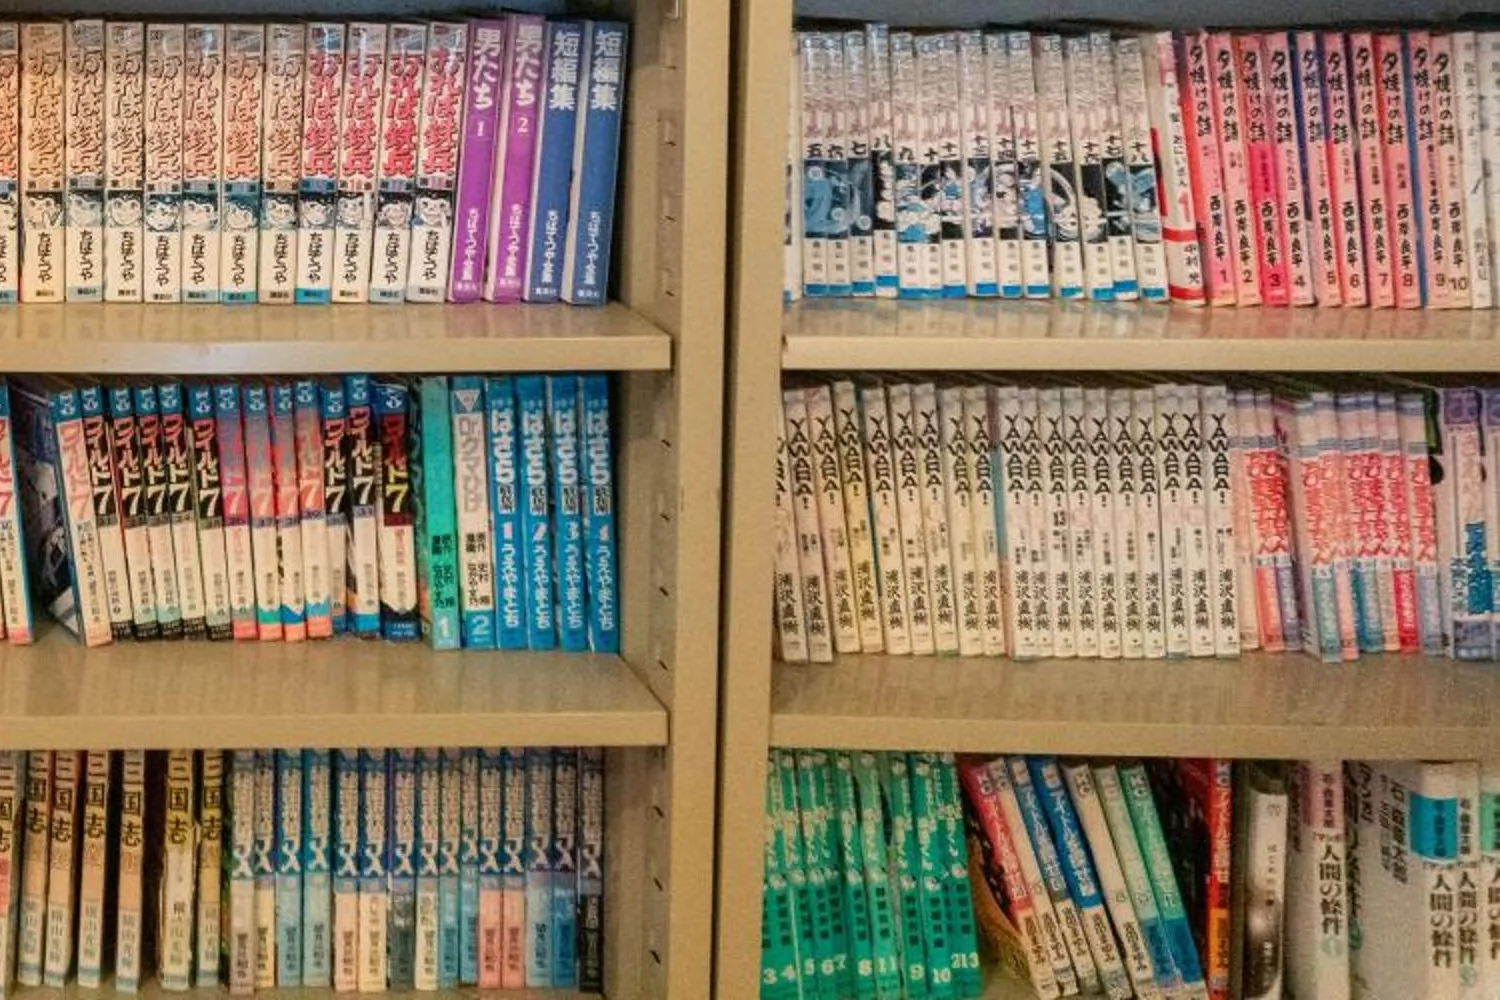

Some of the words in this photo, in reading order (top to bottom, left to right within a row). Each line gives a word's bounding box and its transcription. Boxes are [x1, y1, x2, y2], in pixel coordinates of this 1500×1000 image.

[472, 27, 500, 110] 男たち
[515, 24, 543, 107] 男たち
[550, 31, 580, 111] 短編集
[591, 31, 622, 111] 短編集
[308, 232, 323, 284] ちばてつや
[384, 232, 399, 285] ちばてつや
[1243, 271, 1253, 283] 2
[1350, 274, 1360, 287] 6
[1379, 273, 1389, 286] 7
[1402, 274, 1413, 287] 8
[1449, 276, 1469, 290] 10
[472, 617, 490, 635] 2
[85, 752, 108, 840] 三国志
[121, 752, 145, 847] 三国志
[168, 751, 193, 846] 三国志
